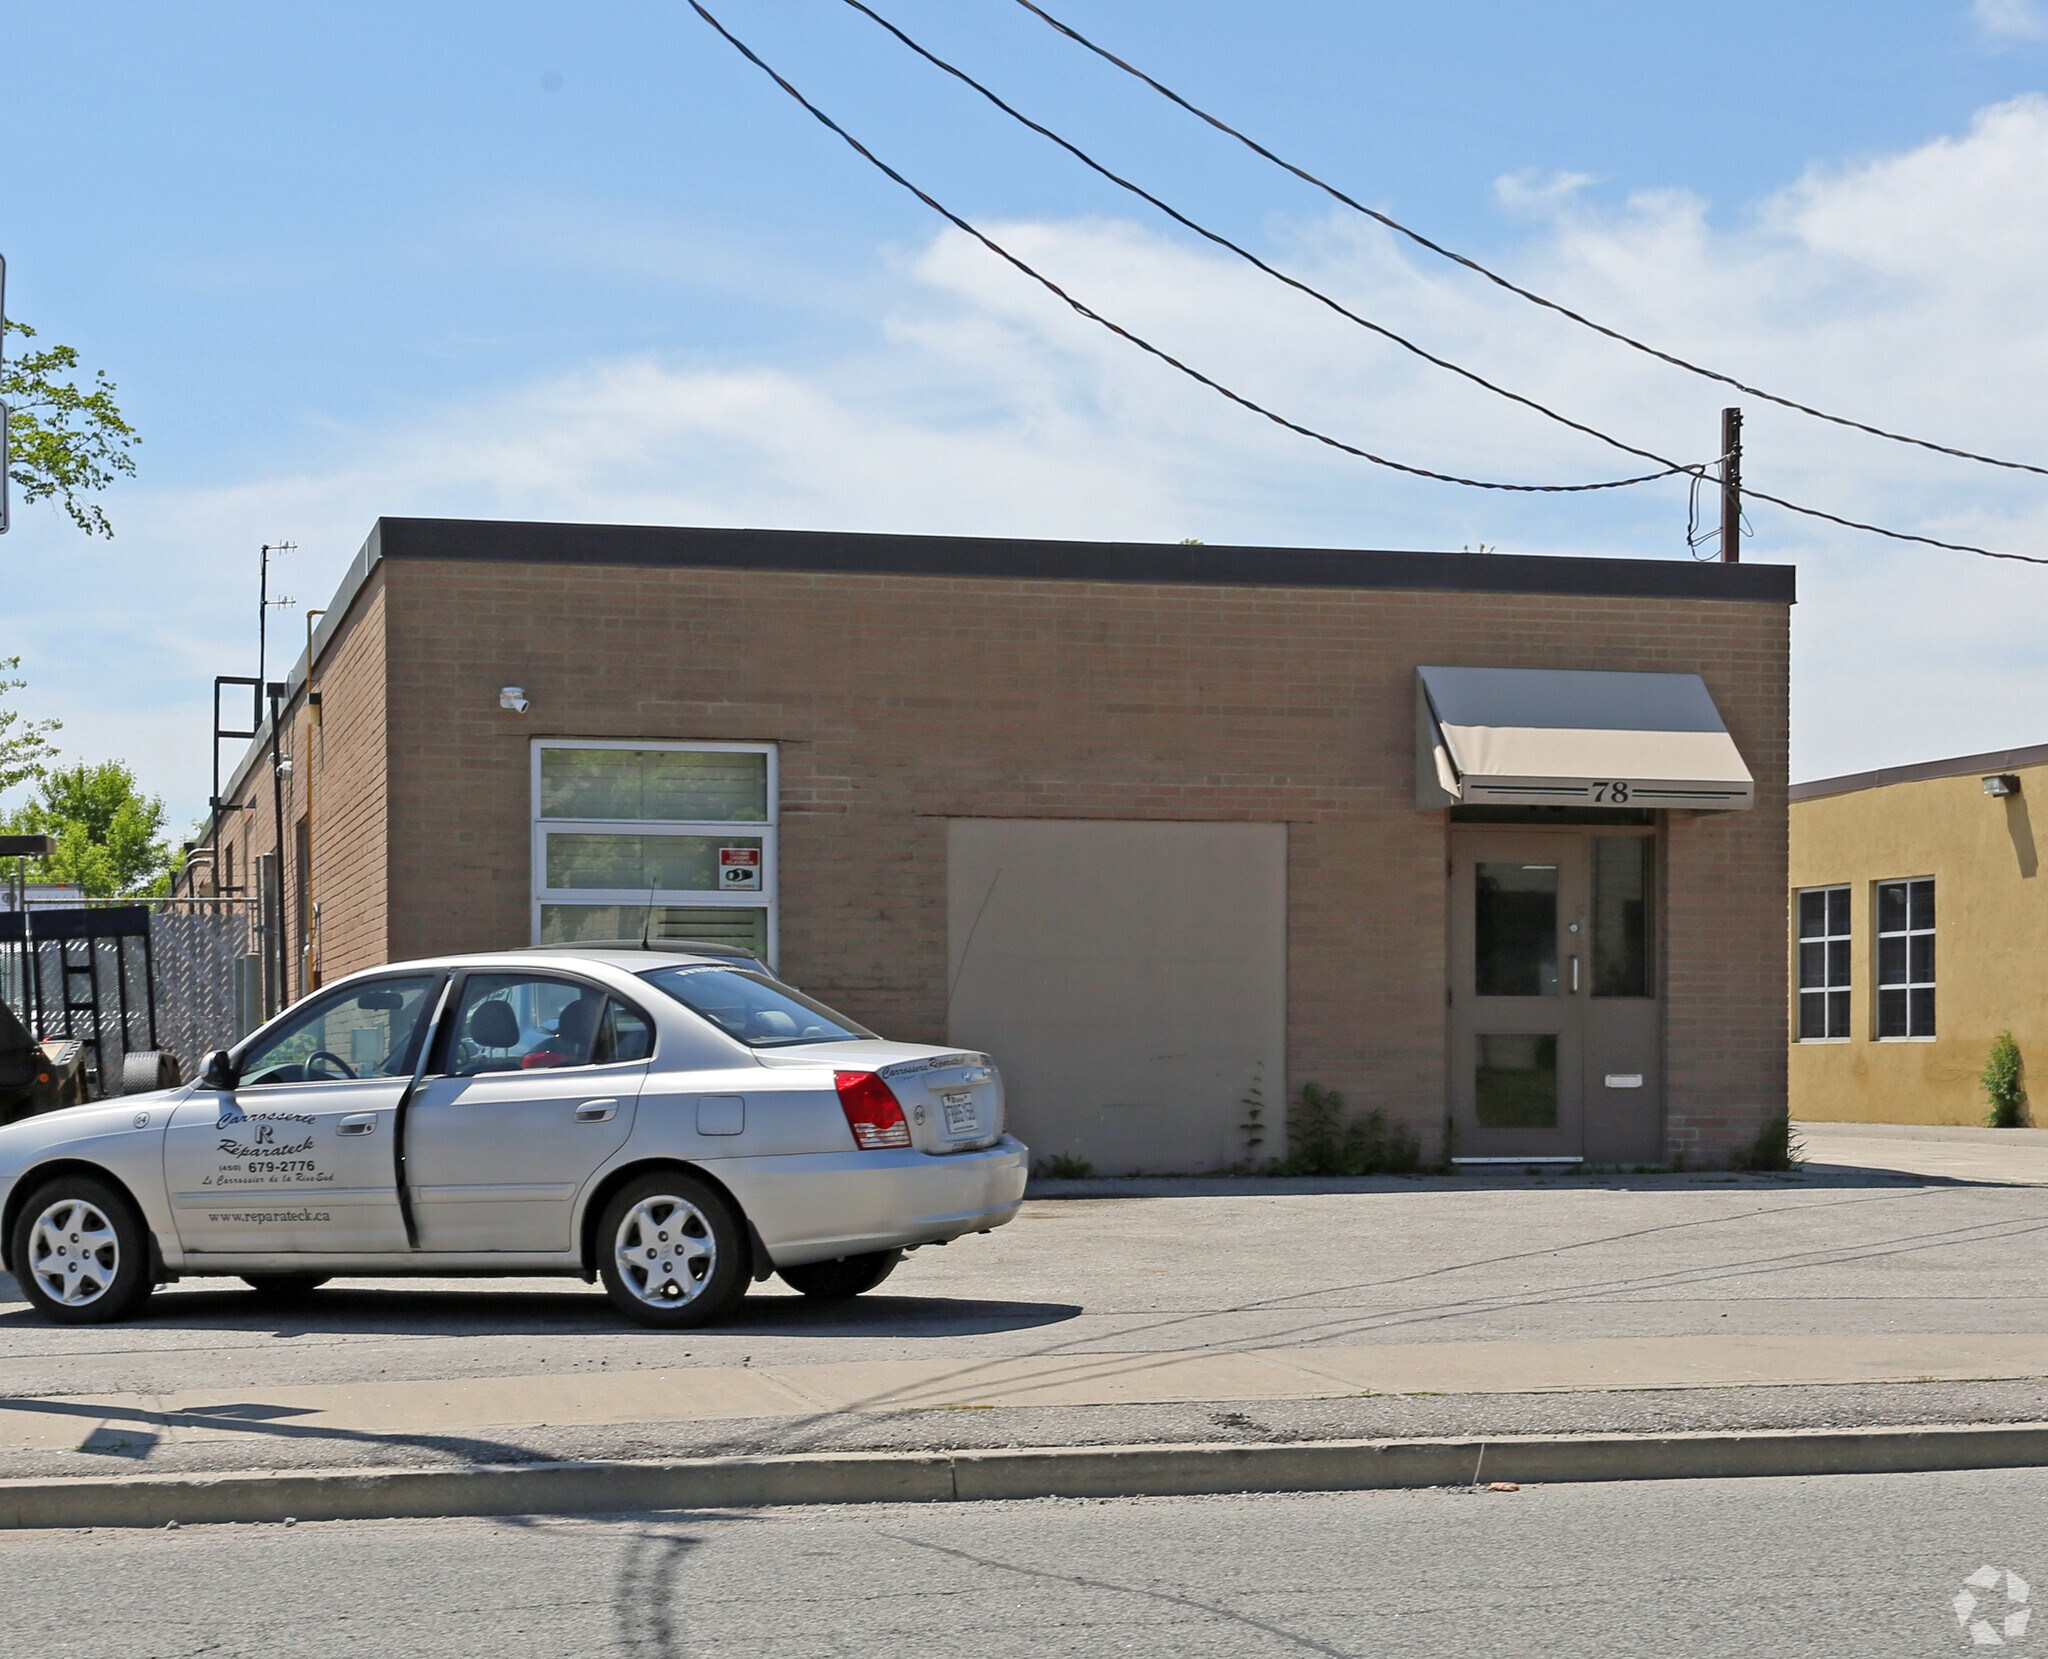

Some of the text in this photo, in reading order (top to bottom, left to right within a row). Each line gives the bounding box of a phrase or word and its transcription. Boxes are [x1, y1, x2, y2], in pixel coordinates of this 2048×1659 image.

[1592, 781, 1629, 803] 78
[215, 1112, 316, 1130] Carrosserie
[254, 1124, 274, 1144] R
[217, 1135, 315, 1158] Réparateck
[248, 1160, 315, 1173] 679-2776
[268, 1174, 278, 1183] de
[282, 1174, 291, 1183] la
[208, 1208, 330, 1225] www.reparateck.ca
